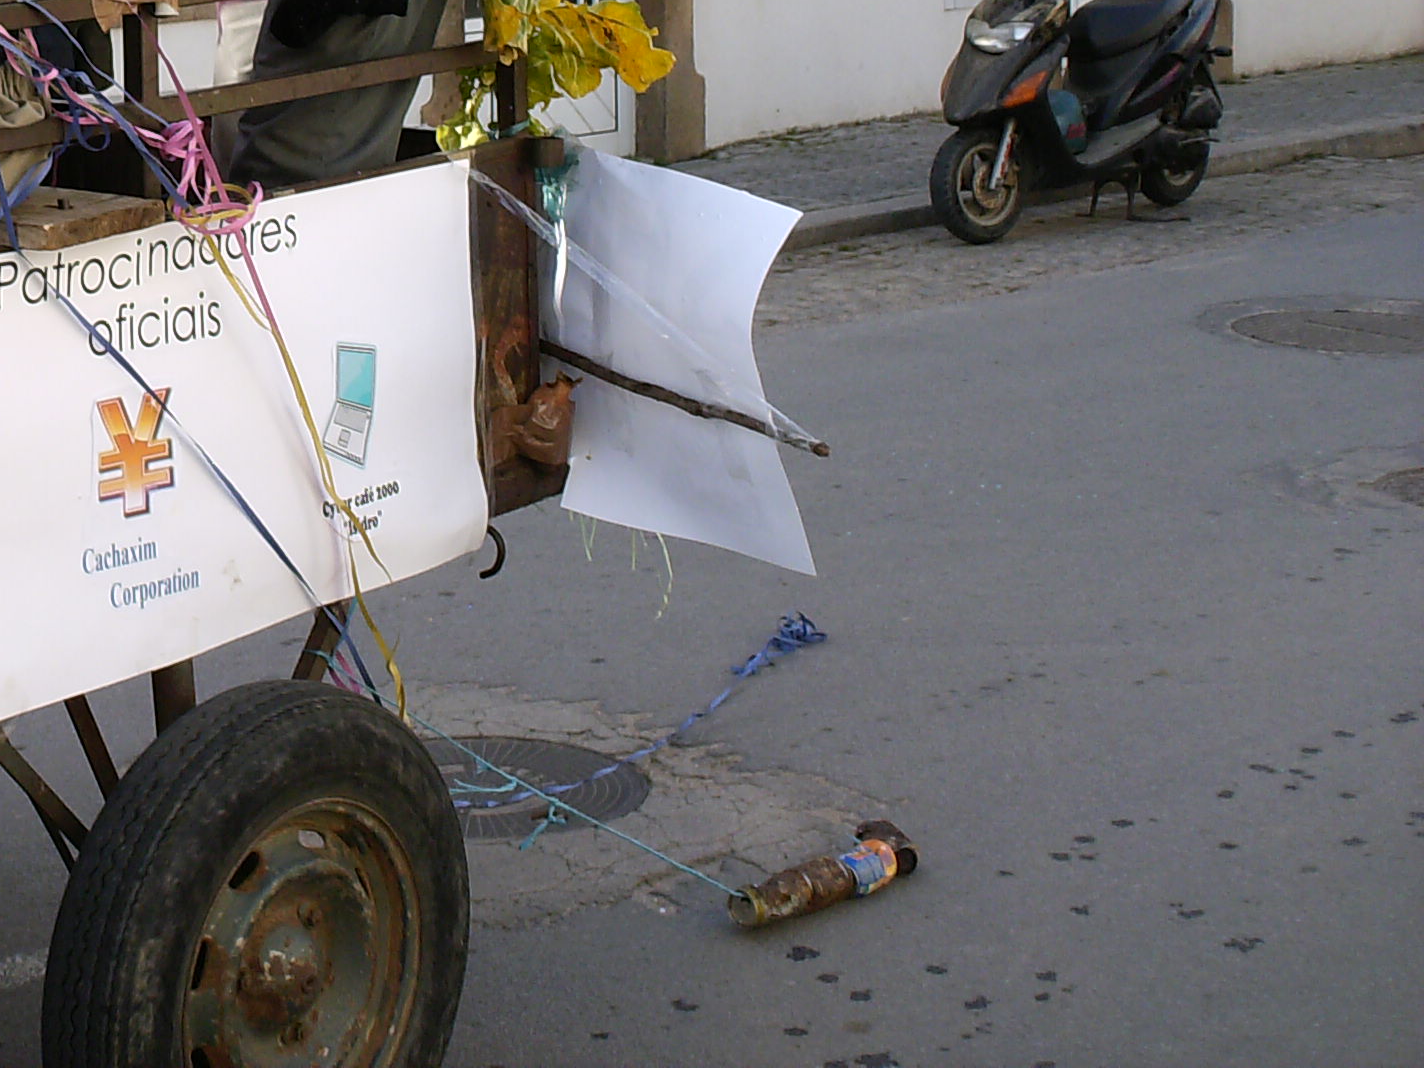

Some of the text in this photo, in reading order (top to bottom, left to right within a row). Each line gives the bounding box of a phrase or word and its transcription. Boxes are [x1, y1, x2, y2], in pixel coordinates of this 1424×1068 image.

[88, 290, 222, 356] oficiais
[355, 486, 374, 507] café
[376, 480, 399, 500] 2000
[81, 535, 158, 574] Cachaxim
[109, 566, 200, 610] Corporation
